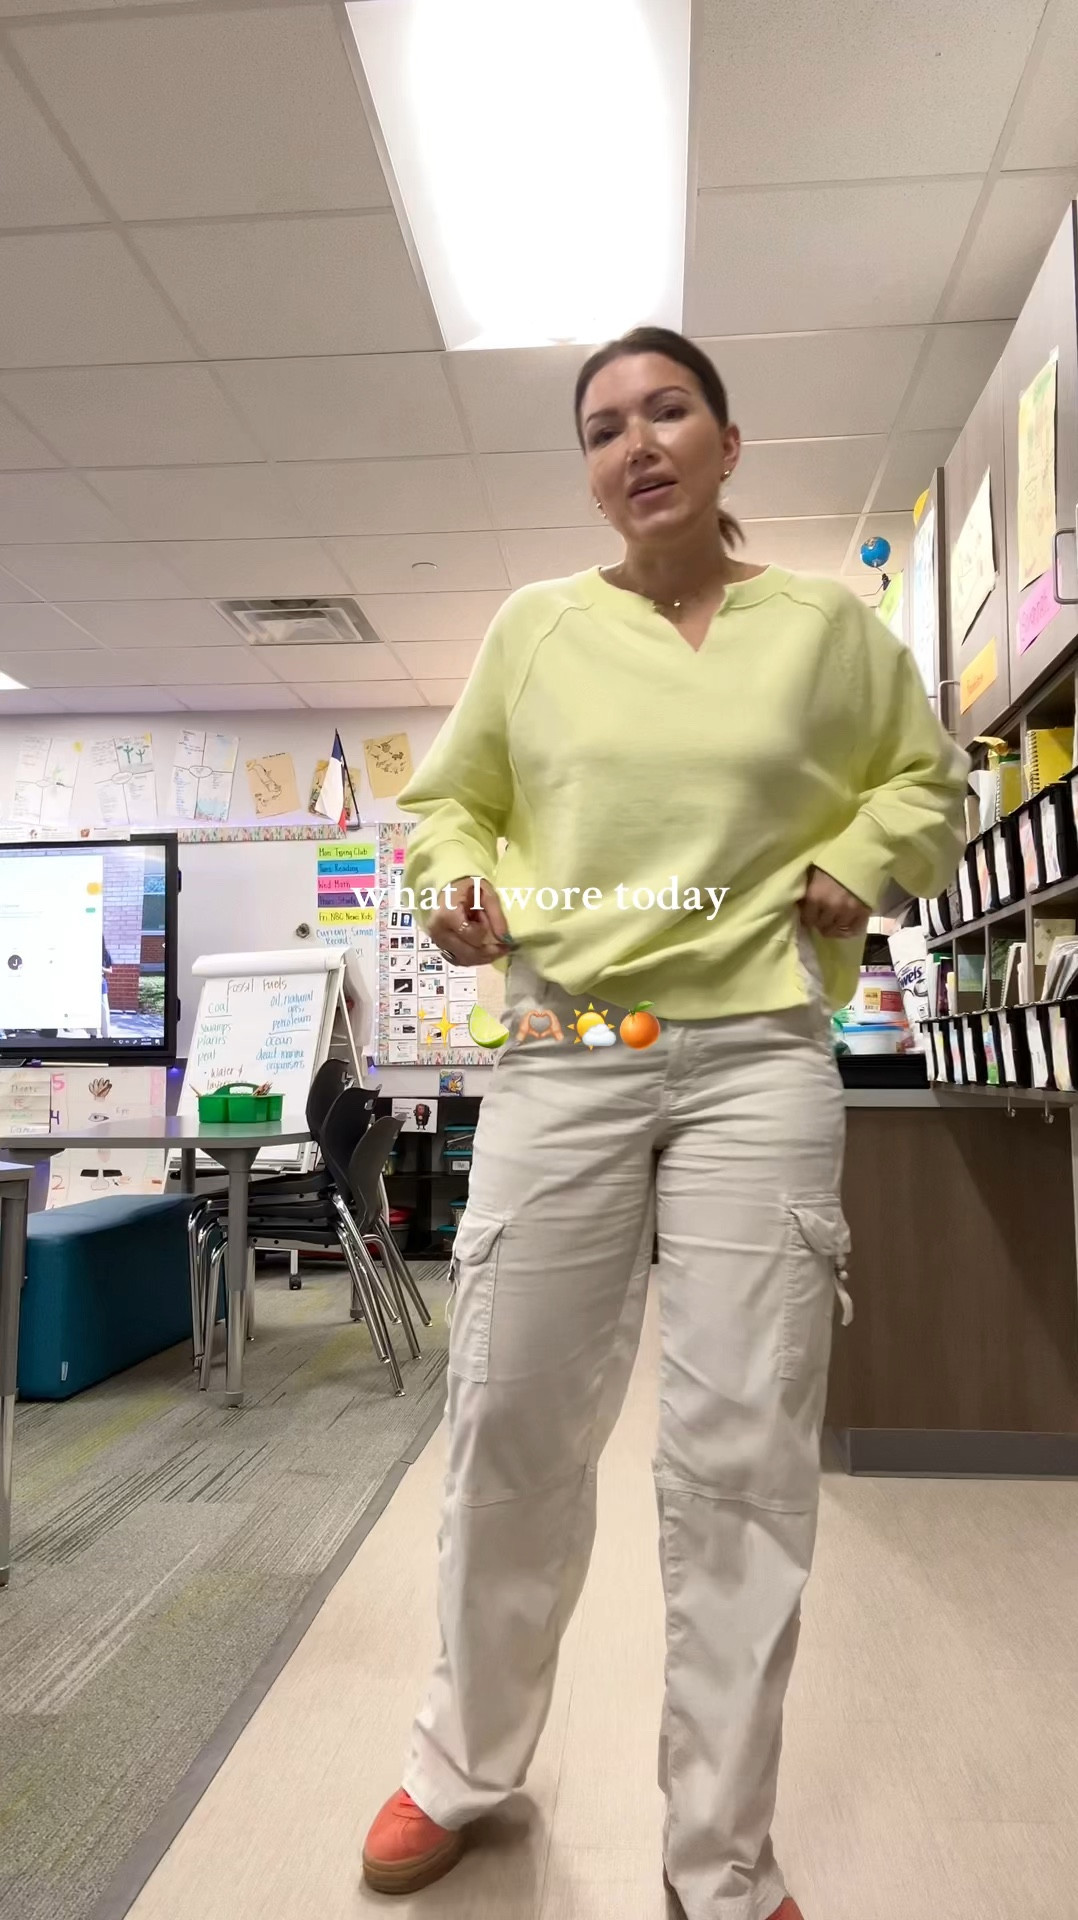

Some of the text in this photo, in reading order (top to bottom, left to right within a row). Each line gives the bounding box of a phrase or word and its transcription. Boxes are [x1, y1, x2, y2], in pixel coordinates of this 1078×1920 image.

[353, 847, 368, 856] Club
[334, 863, 359, 873] Reading
[334, 879, 351, 888] Math
[226, 977, 254, 998] Fossil
[51, 1073, 65, 1091] 5
[51, 1174, 65, 1190] 2
